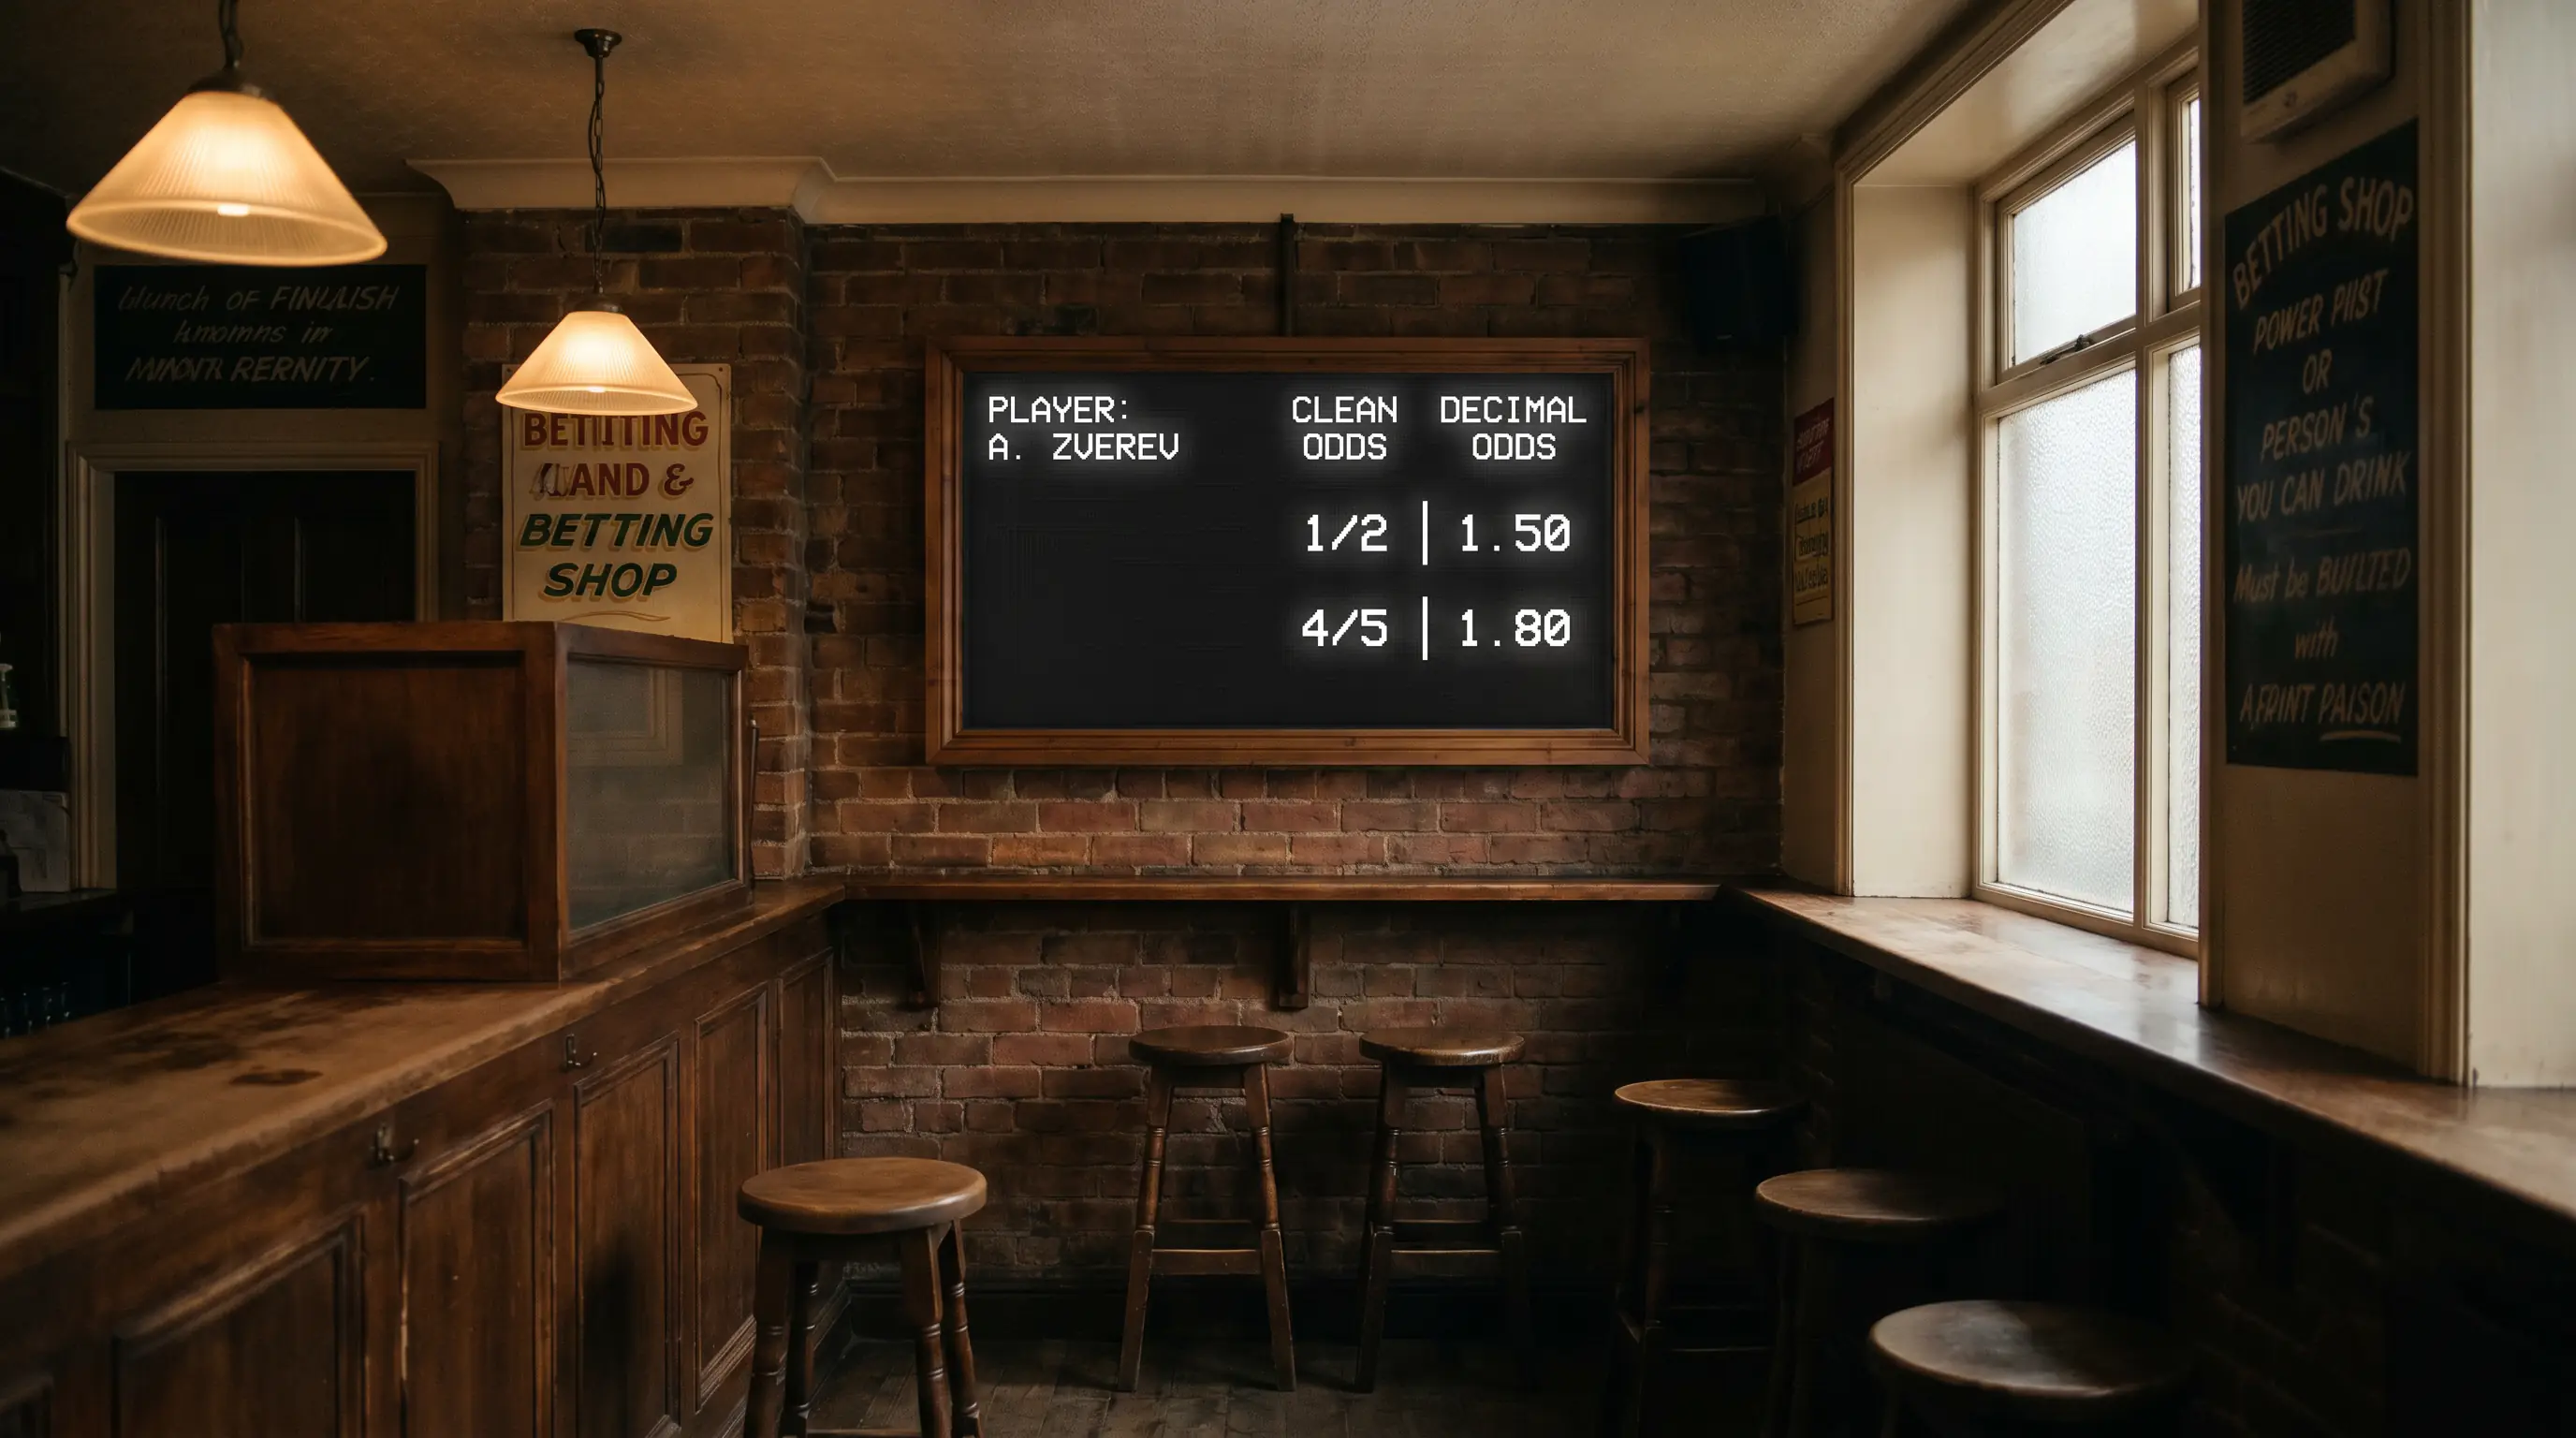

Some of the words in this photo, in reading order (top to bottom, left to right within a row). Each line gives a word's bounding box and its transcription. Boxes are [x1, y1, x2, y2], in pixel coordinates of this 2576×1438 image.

[2232, 183, 2328, 310] BETTING
[2337, 176, 2414, 242] SHOP
[2253, 293, 2324, 356] POWER
[2303, 348, 2333, 394] OR
[989, 396, 1127, 423] PLAYER:
[1293, 396, 1398, 423] CLEAN
[1441, 396, 1588, 423] DECIMAL
[989, 433, 1022, 461] A.
[1053, 433, 1179, 461] ZVEREV
[1304, 433, 1387, 461] ODDS
[1472, 433, 1557, 461] ODDS
[664, 462, 695, 496] &
[2236, 479, 2274, 526] YOU
[2280, 468, 2326, 516] CAN
[2334, 452, 2411, 506] DRINK
[520, 513, 714, 548] BETTING
[1307, 514, 1388, 552] 1/2
[1462, 514, 1571, 552] 1.50
[543, 562, 678, 597] SHOP
[2233, 564, 2280, 604] Must
[2285, 557, 2309, 602] be
[1302, 609, 1388, 647] 4/5
[1462, 609, 1571, 647] 1.80
[2294, 615, 2338, 659] with
